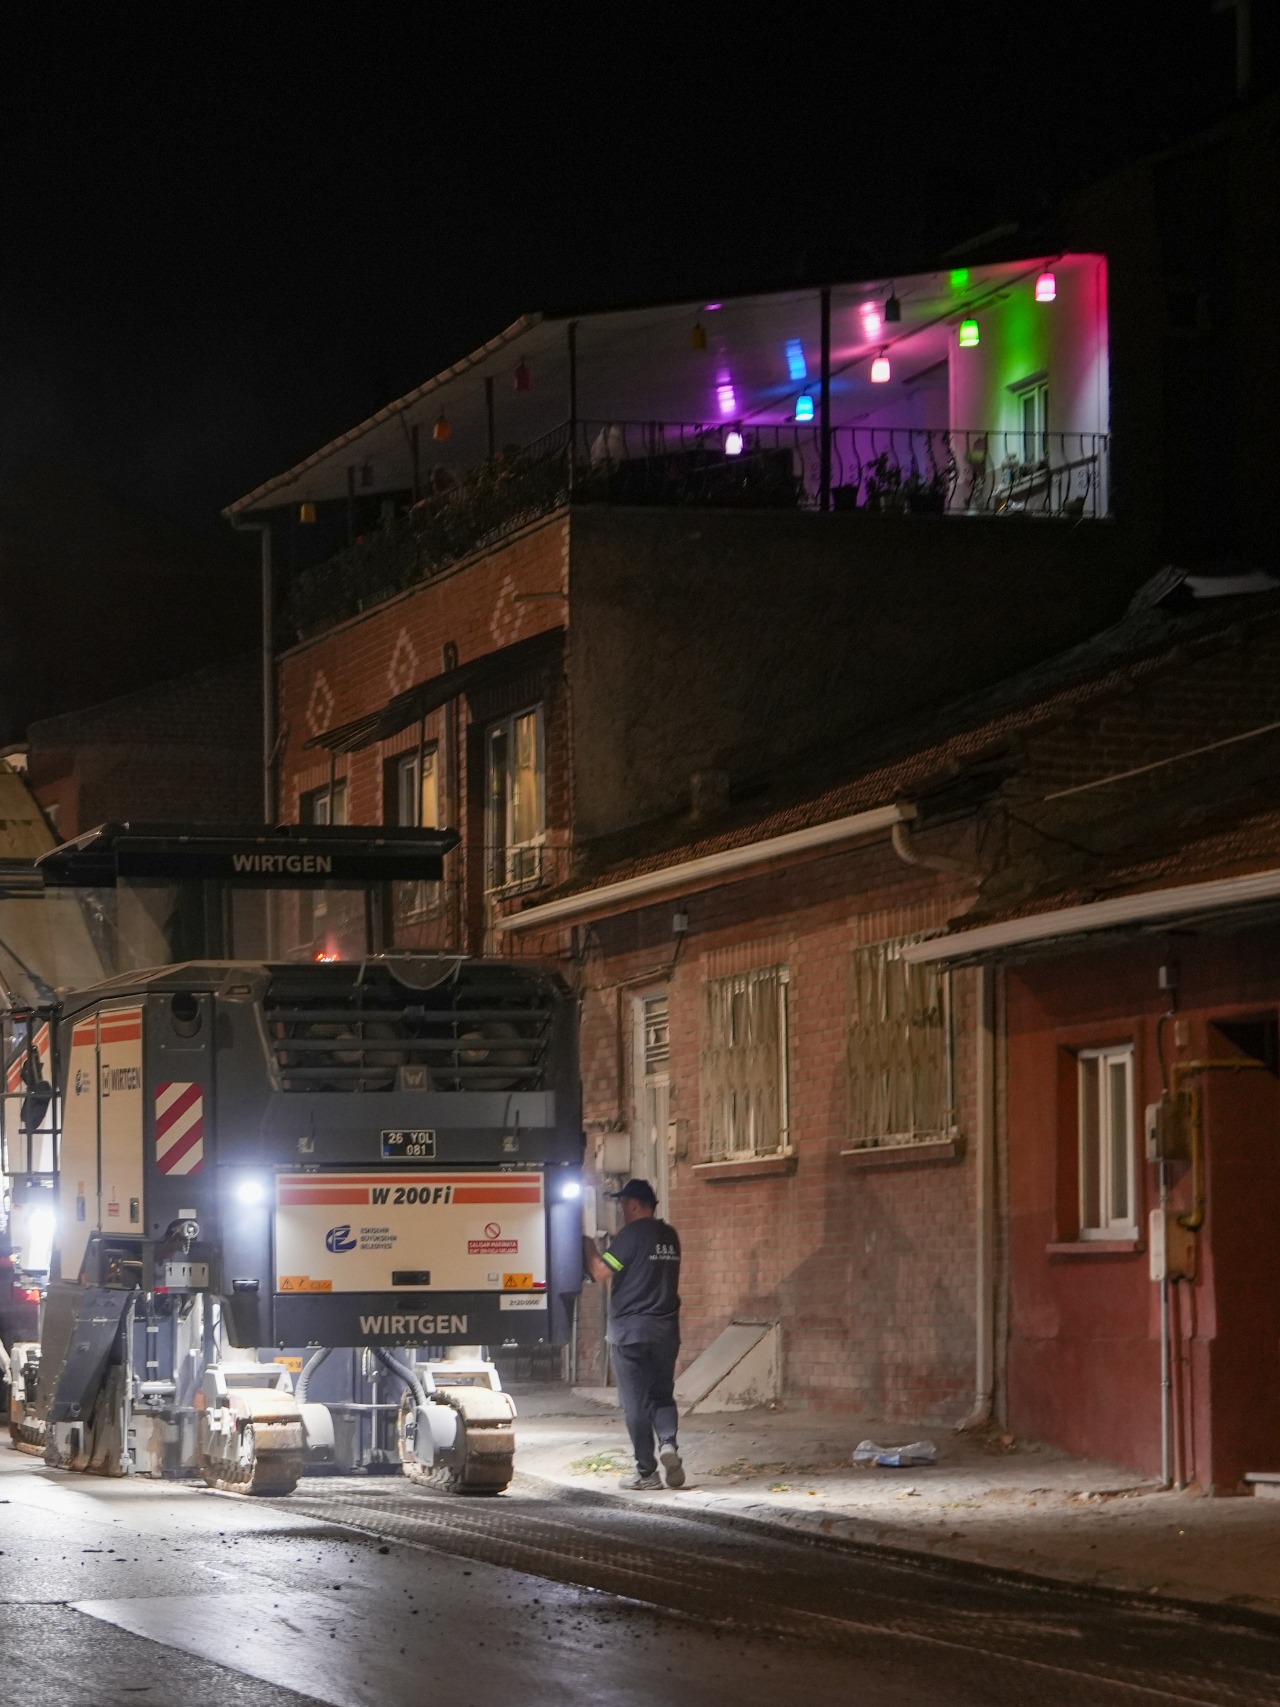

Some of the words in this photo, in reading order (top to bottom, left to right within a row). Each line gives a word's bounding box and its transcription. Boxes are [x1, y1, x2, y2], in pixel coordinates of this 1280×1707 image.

[232, 854, 332, 873] WIRTGEN
[111, 1067, 141, 1091] WIRTGEN
[388, 1132, 404, 1145] 26
[410, 1132, 433, 1144] YOL
[406, 1144, 426, 1156] 081
[372, 1187, 391, 1205] W
[393, 1185, 451, 1205] 200Fi
[360, 1314, 468, 1334] WIRTGEN
